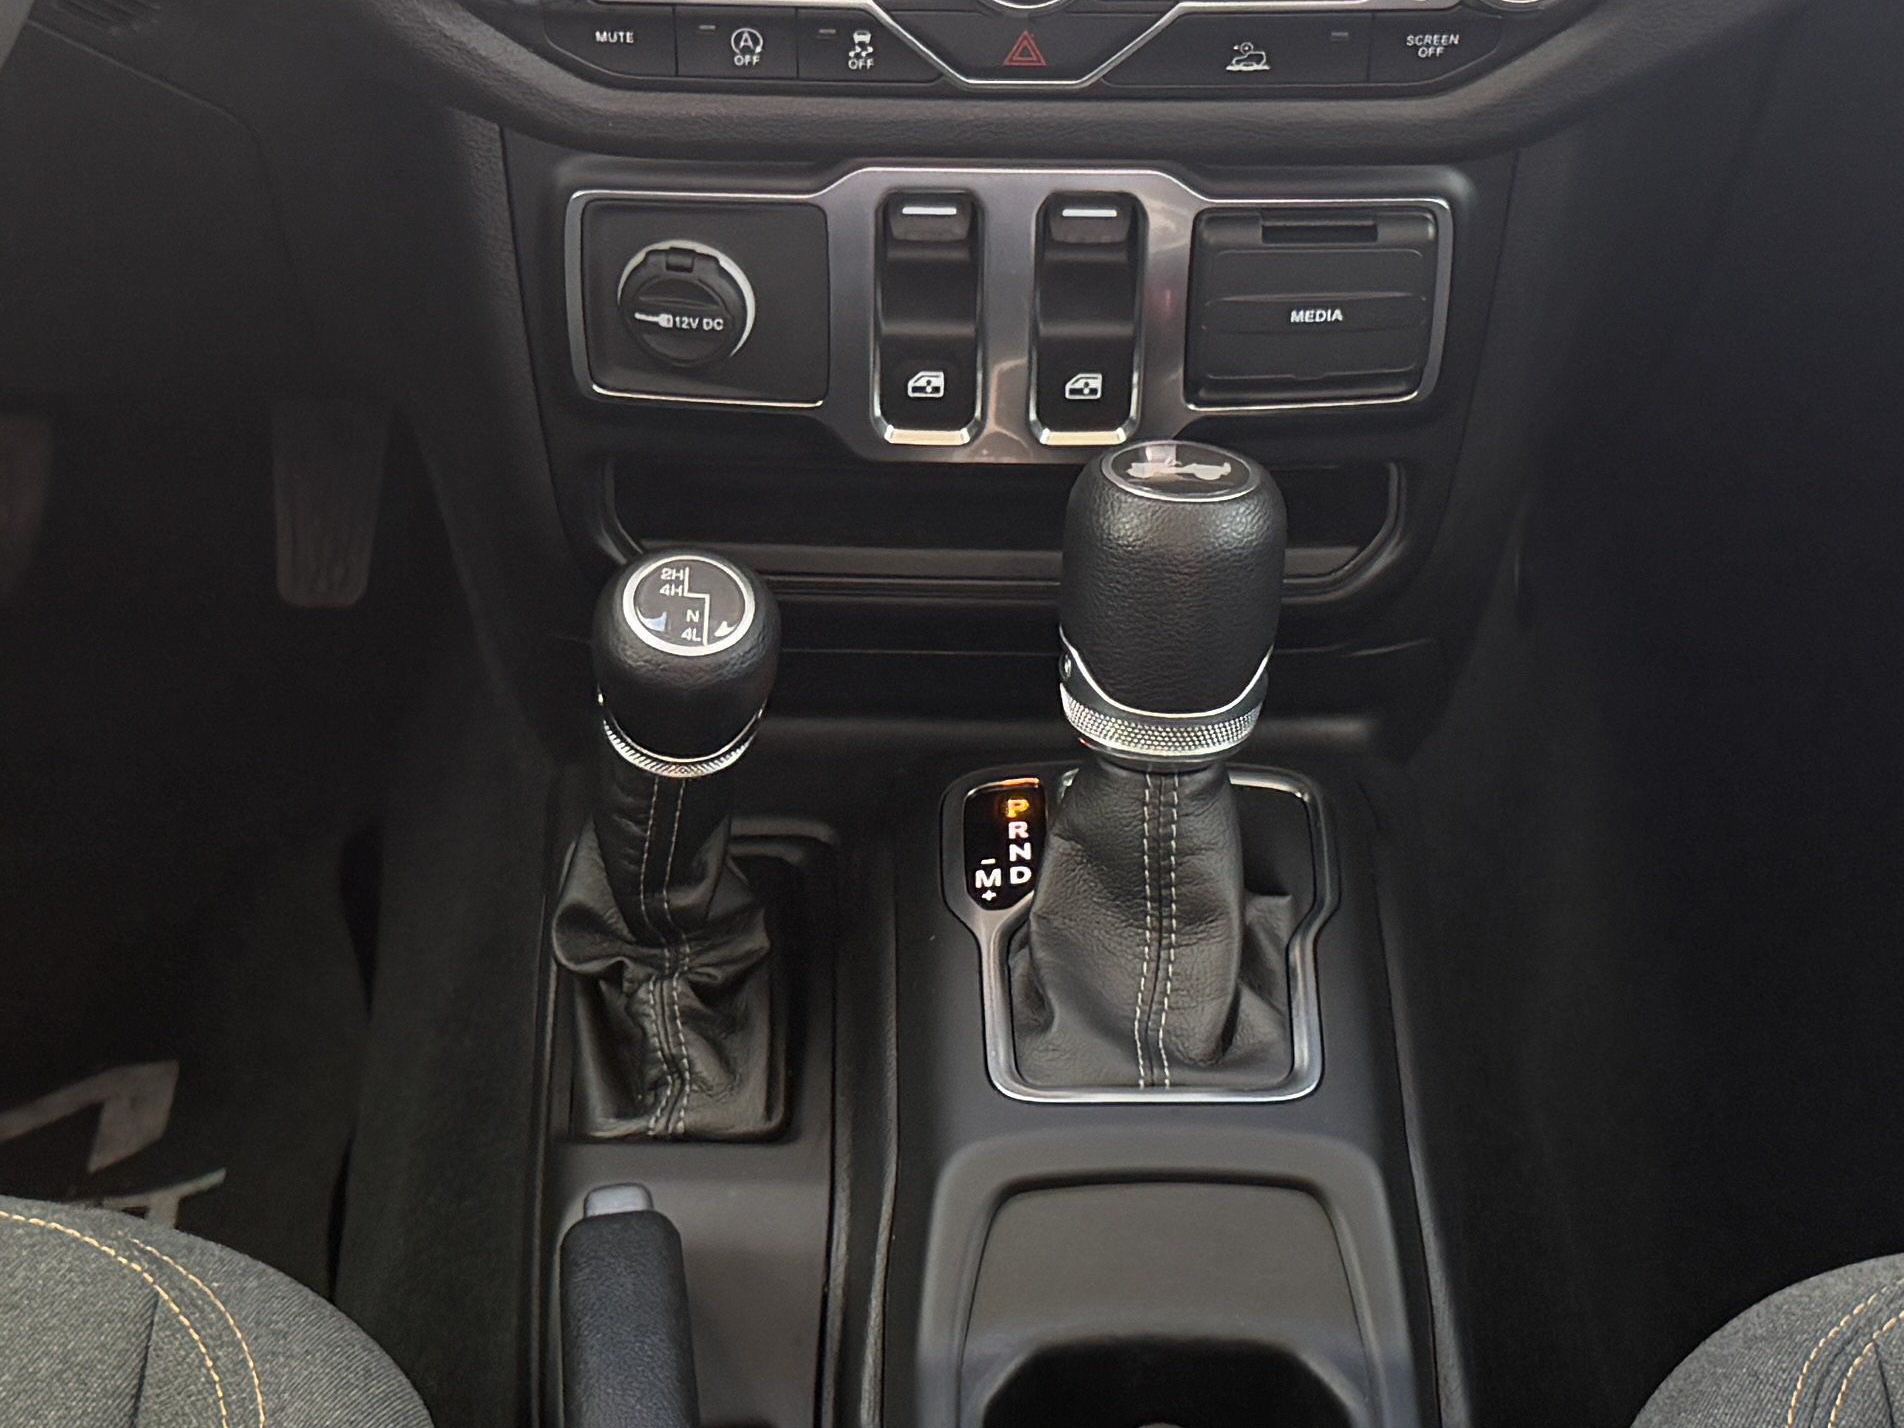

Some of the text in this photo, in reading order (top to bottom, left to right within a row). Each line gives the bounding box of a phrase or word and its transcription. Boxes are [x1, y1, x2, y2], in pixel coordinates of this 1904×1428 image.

[595, 31, 634, 44] MUTE
[1406, 33, 1460, 47] SCREEN
[1418, 46, 1444, 59] OFF
[733, 54, 761, 67] OFF
[848, 57, 875, 71] OFF
[1290, 307, 1343, 324] MEDIA
[675, 316, 724, 331] 12V DC
[660, 567, 684, 581] 2H
[659, 583, 684, 597] 4H
[686, 609, 700, 623] N
[681, 627, 701, 642] 4L
[1007, 798, 1030, 818] P
[1008, 821, 1029, 839] R
[1009, 842, 1032, 862] N
[975, 868, 1002, 888] M
[1009, 866, 1032, 885] D
